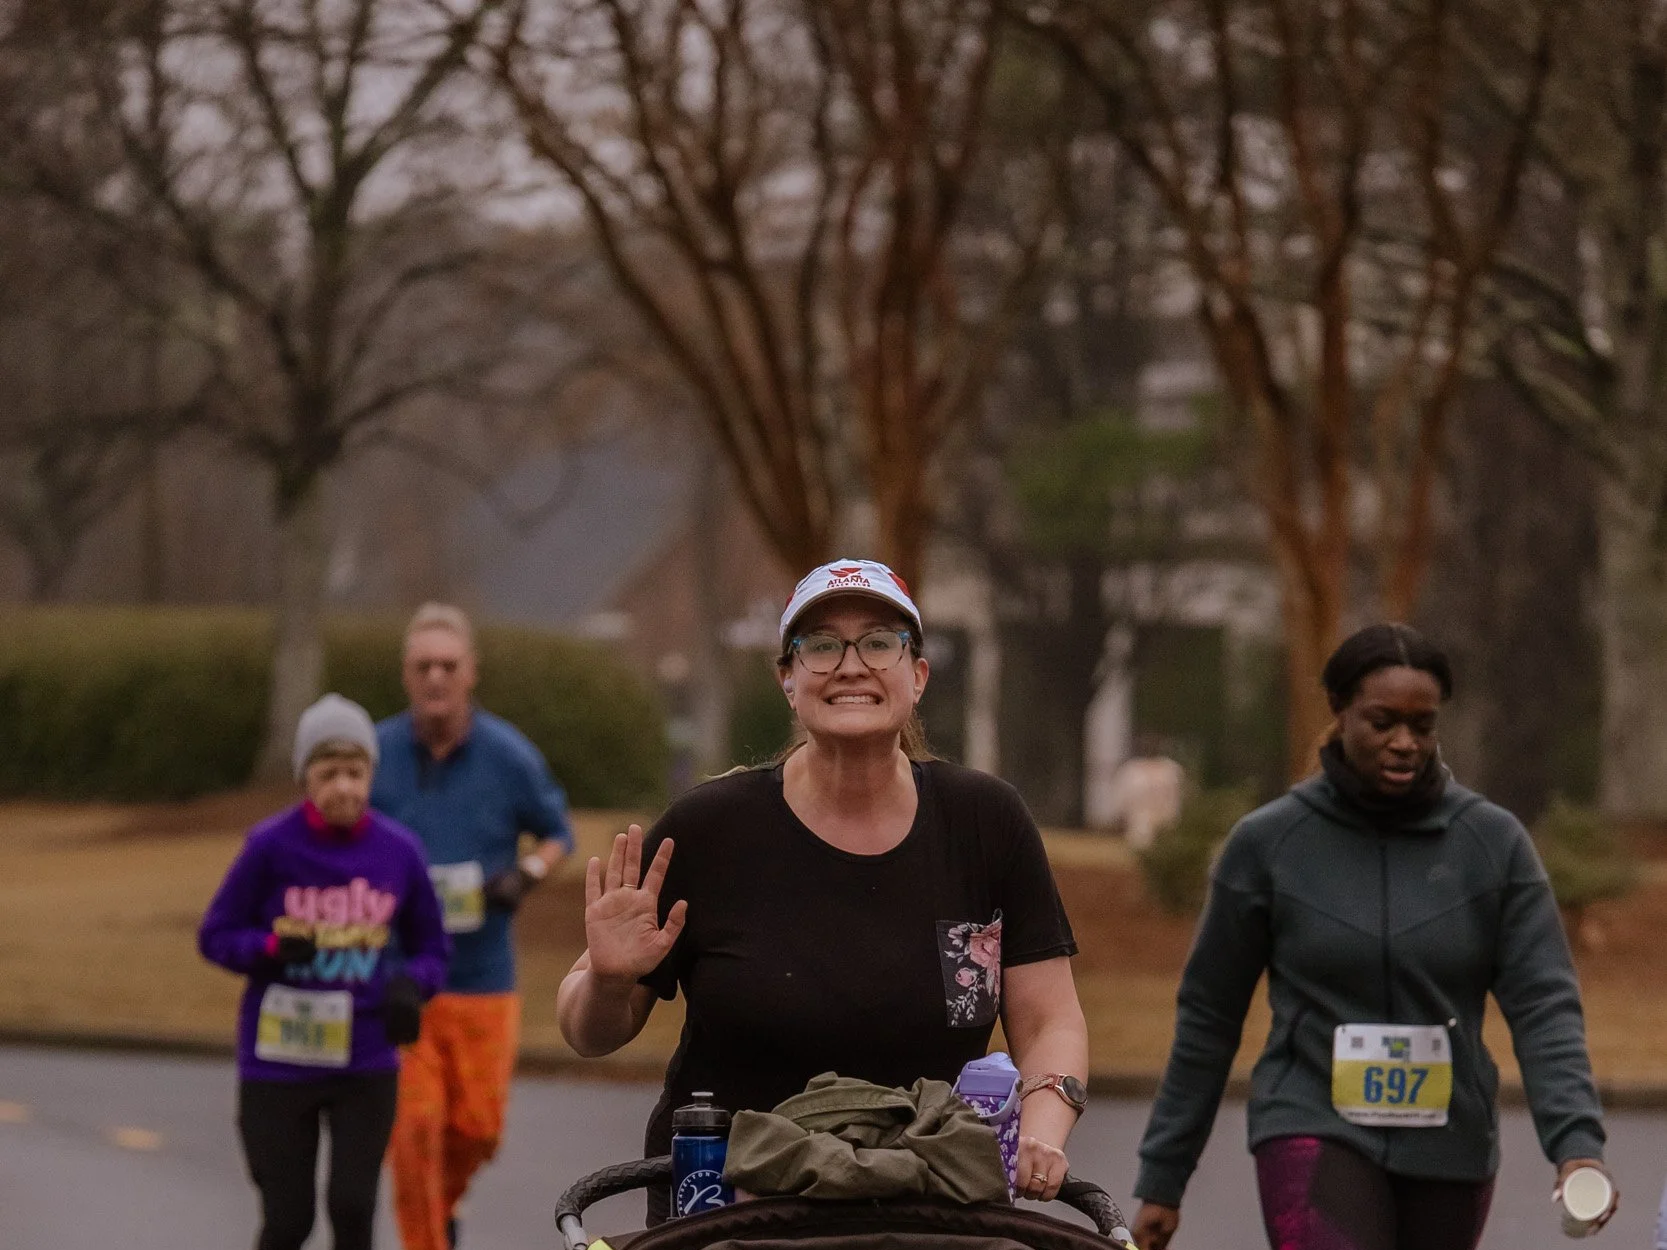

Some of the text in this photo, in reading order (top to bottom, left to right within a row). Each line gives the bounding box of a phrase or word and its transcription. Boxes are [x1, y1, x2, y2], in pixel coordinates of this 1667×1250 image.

[827, 576, 871, 586] ATLANTA
[284, 876, 397, 926] ugly
[1363, 1066, 1429, 1105] 697
